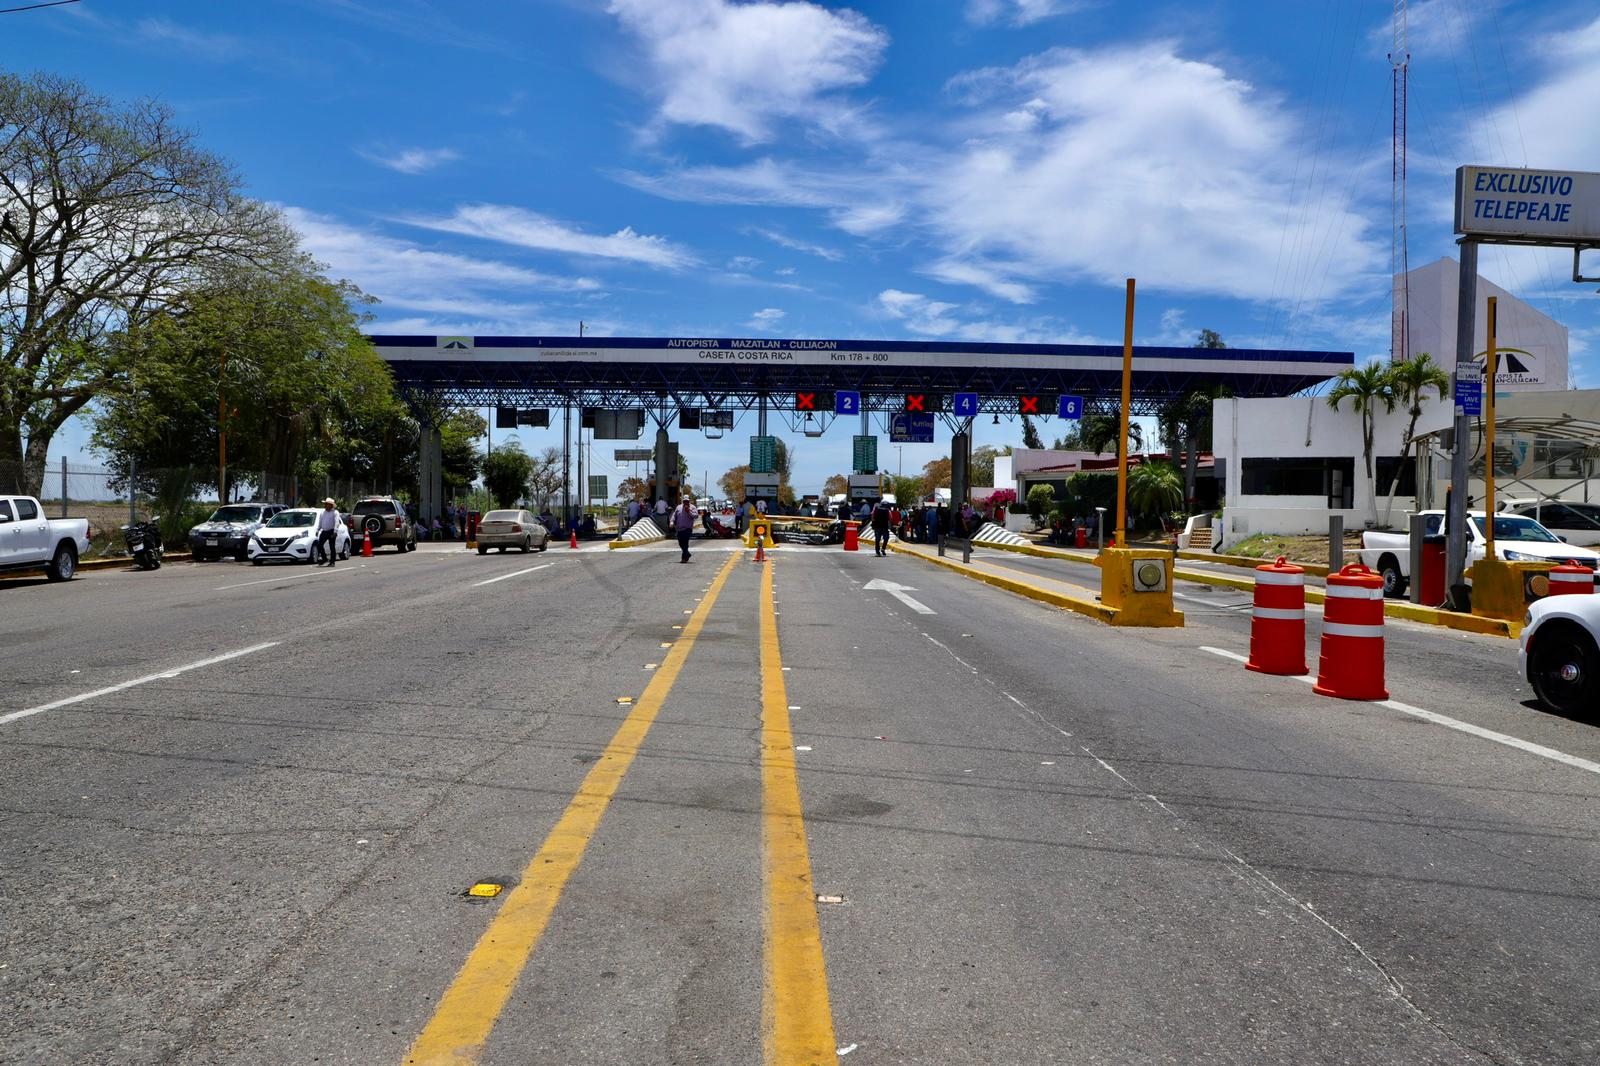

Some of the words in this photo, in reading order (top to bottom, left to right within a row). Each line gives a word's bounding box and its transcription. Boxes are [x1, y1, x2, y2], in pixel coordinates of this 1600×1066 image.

[1474, 172, 1573, 196] EXCLUSIVO
[1474, 199, 1572, 222] TELEPEAJE
[667, 339, 719, 348] AUTOPISTA
[731, 340, 780, 348] MAZATLAN
[789, 341, 837, 349] CULIACAN
[698, 350, 736, 360] CASETA
[738, 351, 769, 360] COSTA
[771, 352, 793, 360] RICA
[830, 353, 846, 361] Km
[849, 353, 863, 361] 178
[872, 353, 888, 361] 800
[843, 396, 852, 409] 2
[961, 397, 970, 410] 4
[1067, 401, 1075, 413] 6
